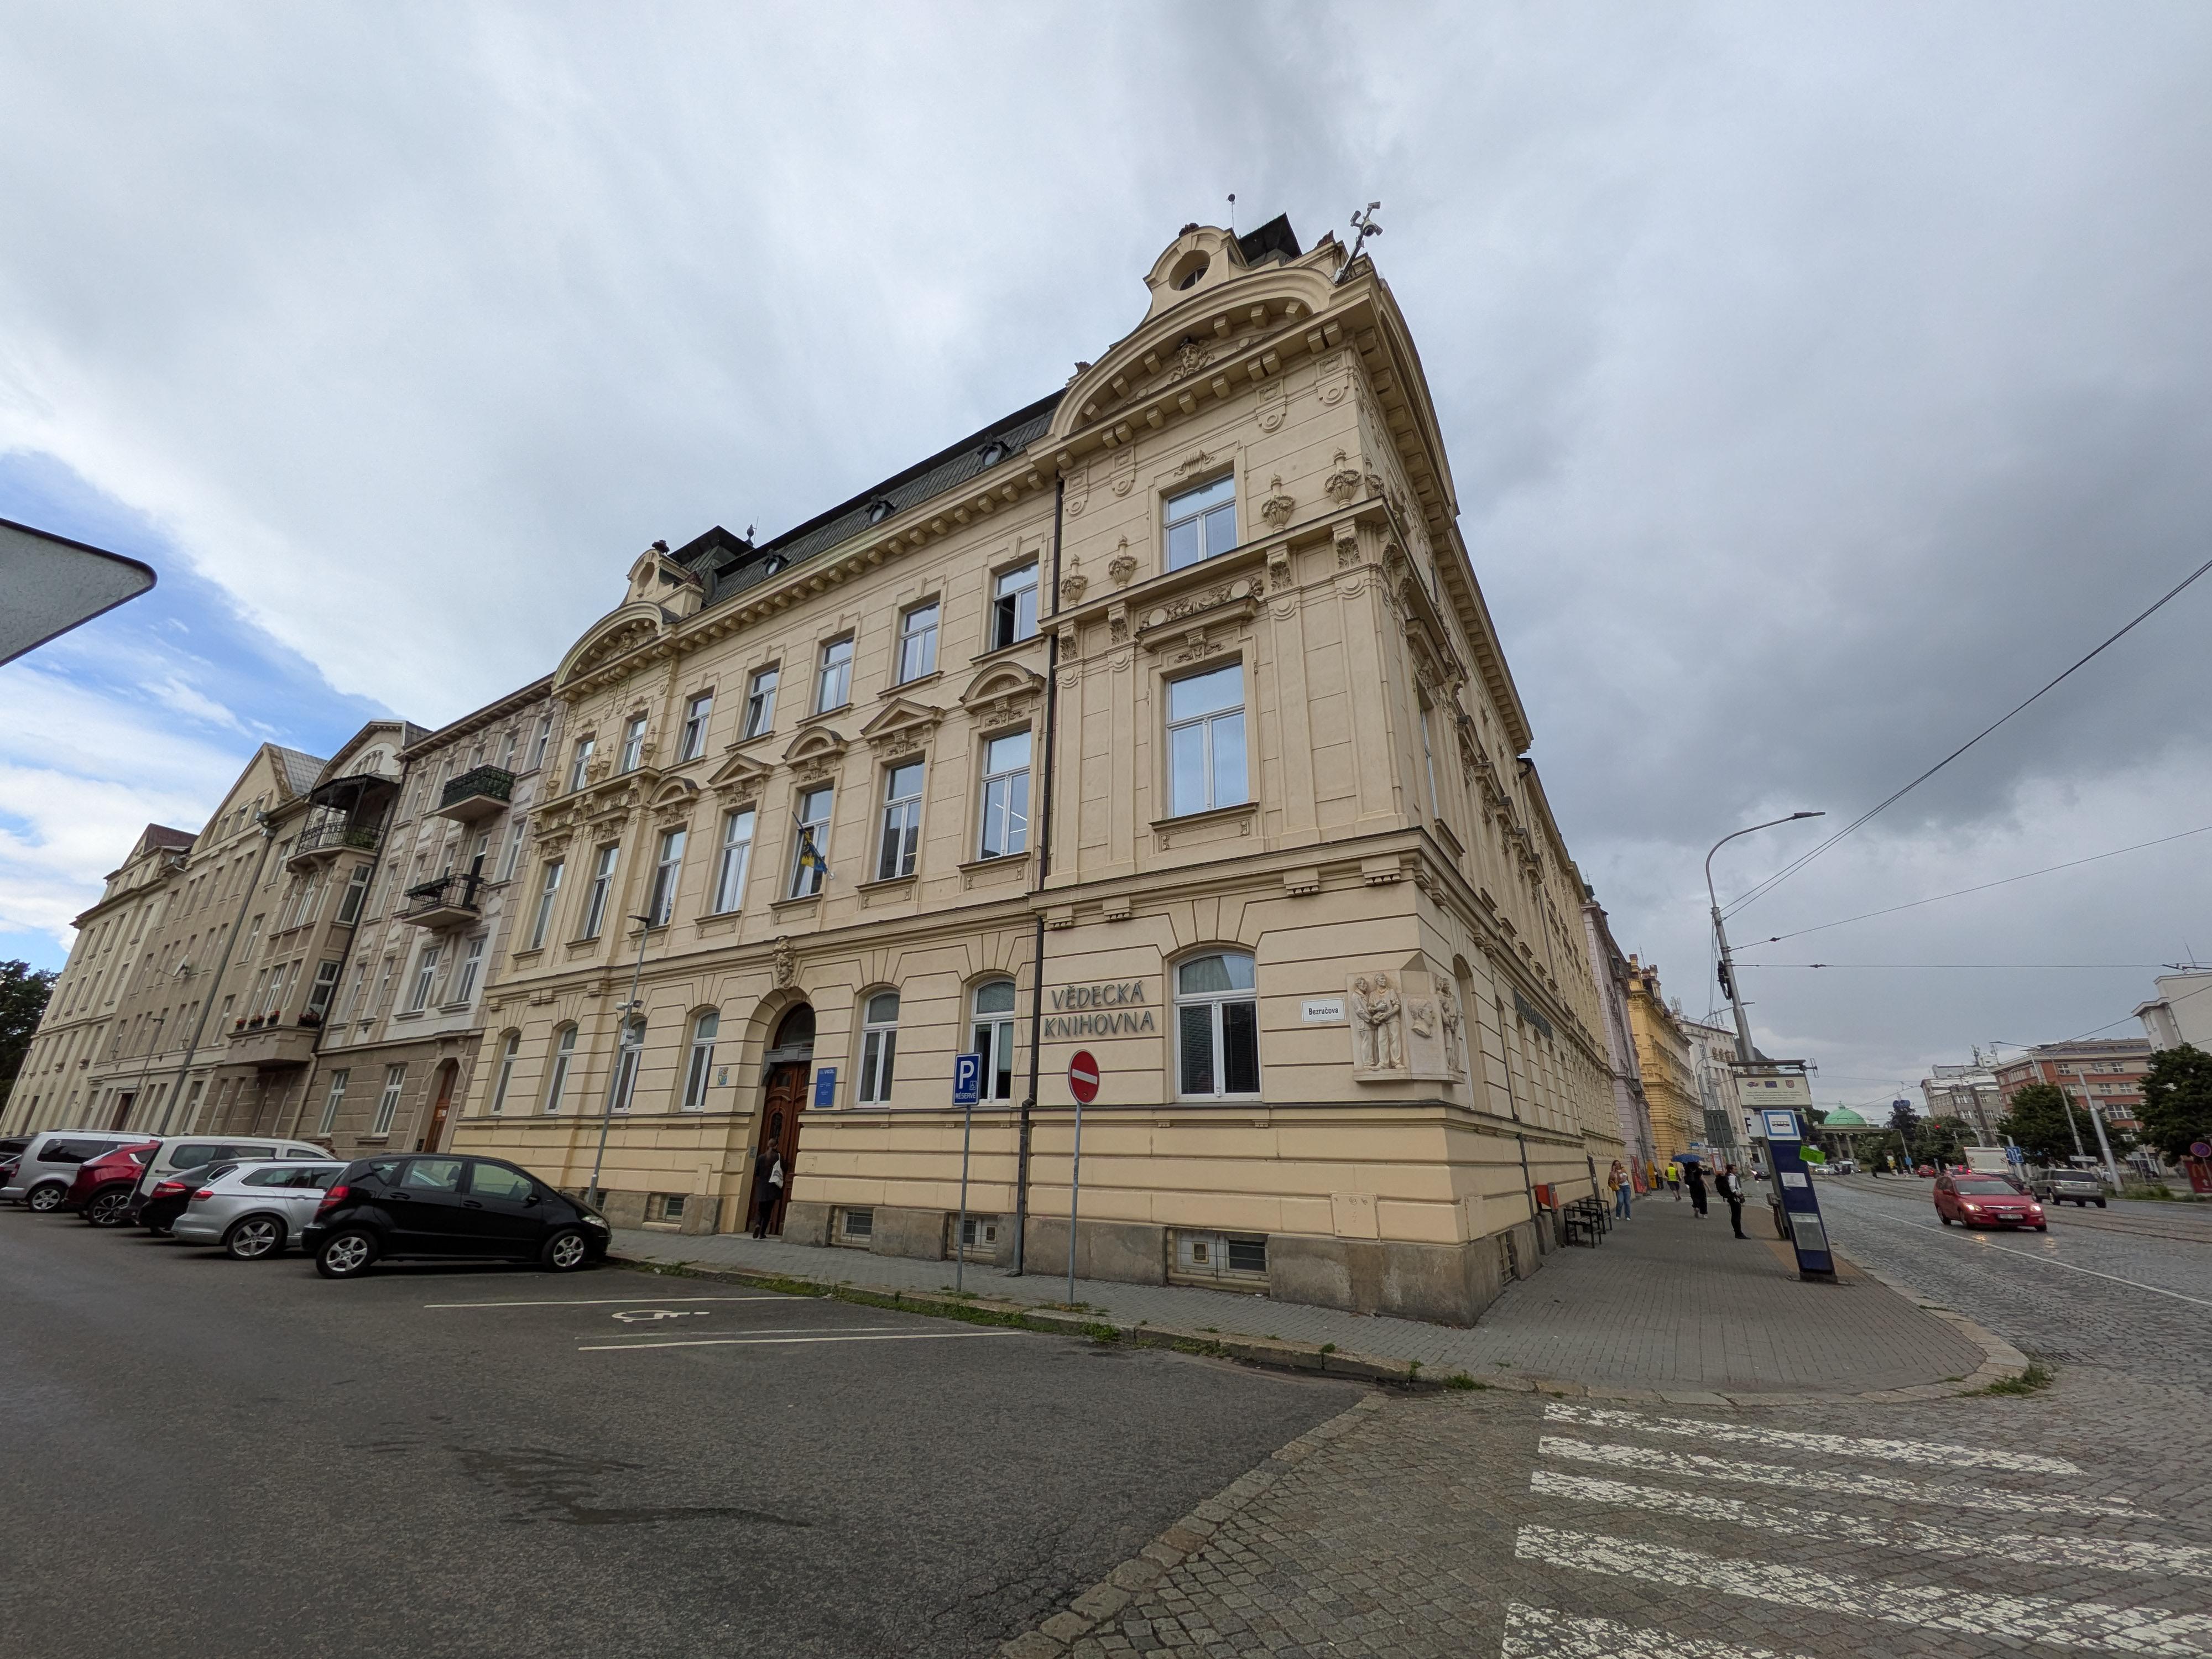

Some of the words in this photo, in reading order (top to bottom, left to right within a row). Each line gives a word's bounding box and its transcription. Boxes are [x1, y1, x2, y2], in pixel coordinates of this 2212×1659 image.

[1051, 980, 1144, 1009] VĚDECKÁ
[1044, 1010, 1155, 1037] KNIHOVNA
[1308, 1006, 1339, 1015] Bezručova
[959, 1060, 974, 1089] P
[1744, 1117, 1752, 1134] F
